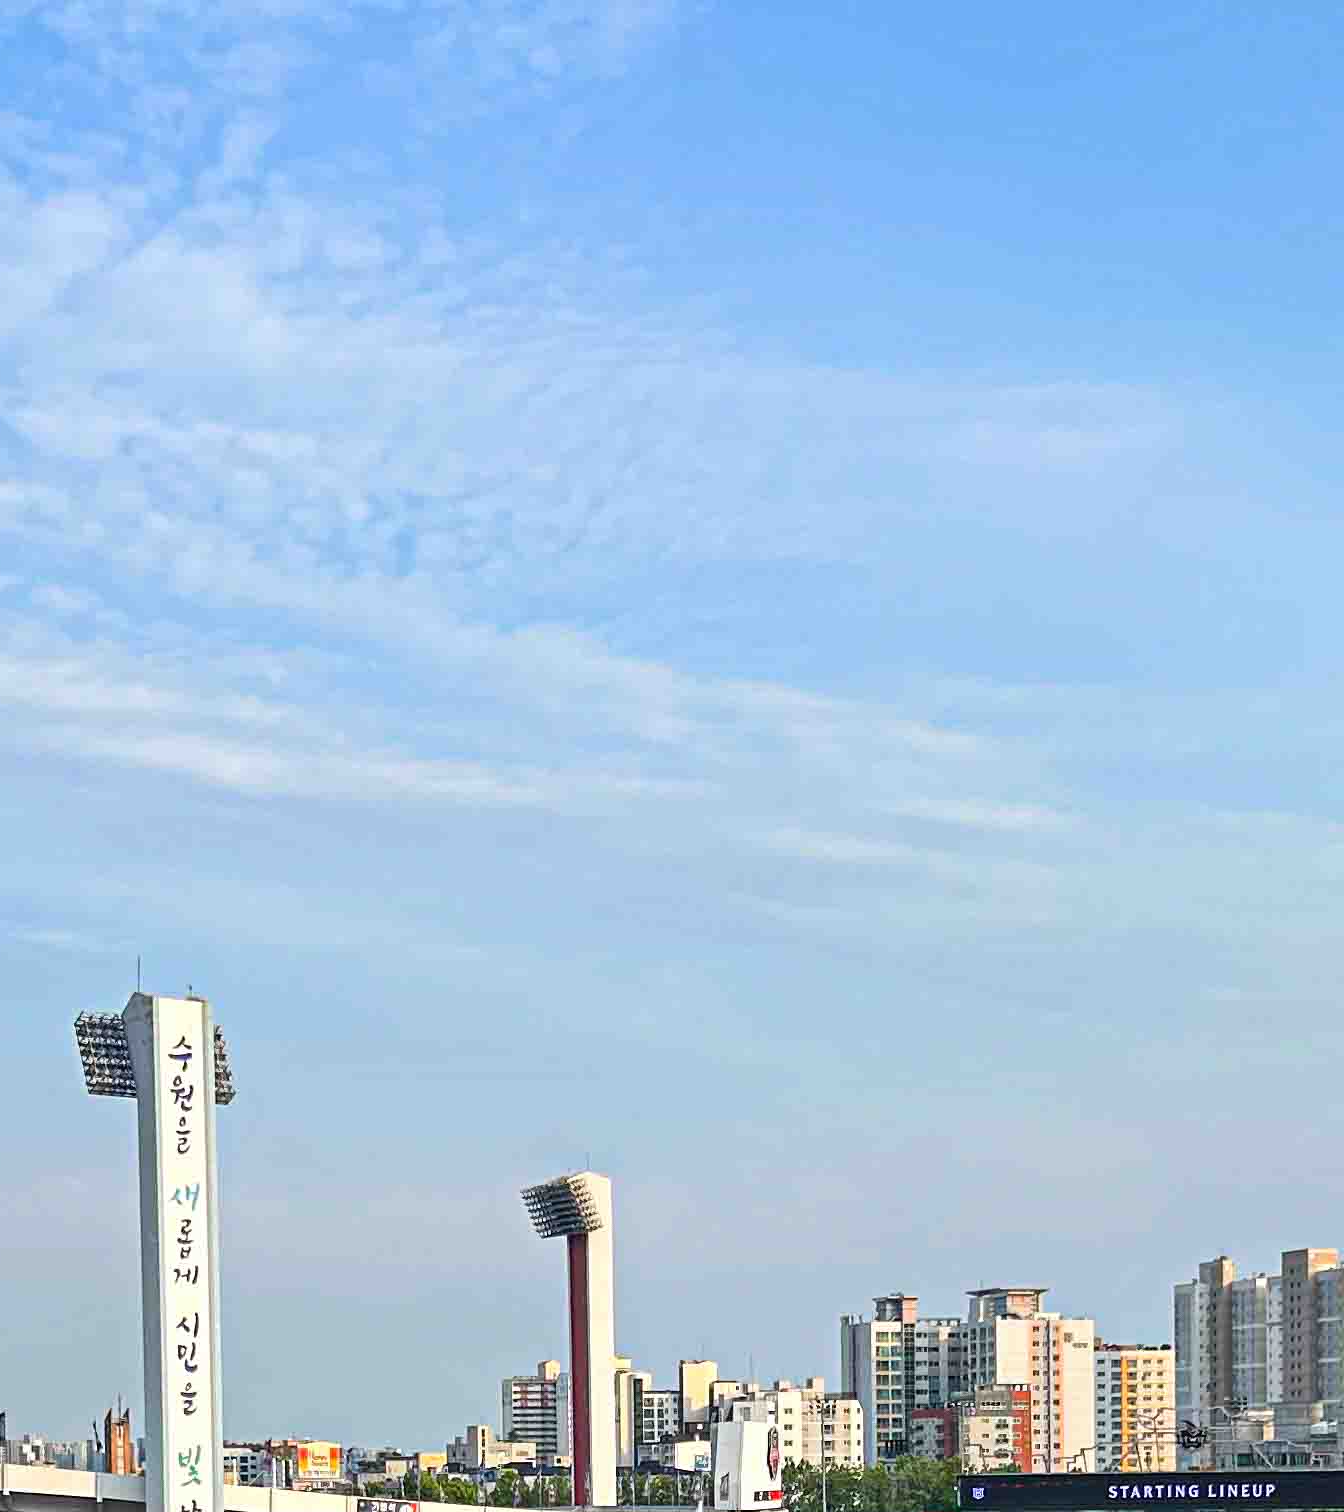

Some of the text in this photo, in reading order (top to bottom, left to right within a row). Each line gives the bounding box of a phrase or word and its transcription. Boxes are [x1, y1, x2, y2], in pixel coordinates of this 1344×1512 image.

[168, 1034, 194, 1155] 수원을
[170, 1181, 200, 1287] 새롭게
[177, 1311, 200, 1417] 시민을
[1108, 1484, 1276, 1499] STARTING LINEUP
